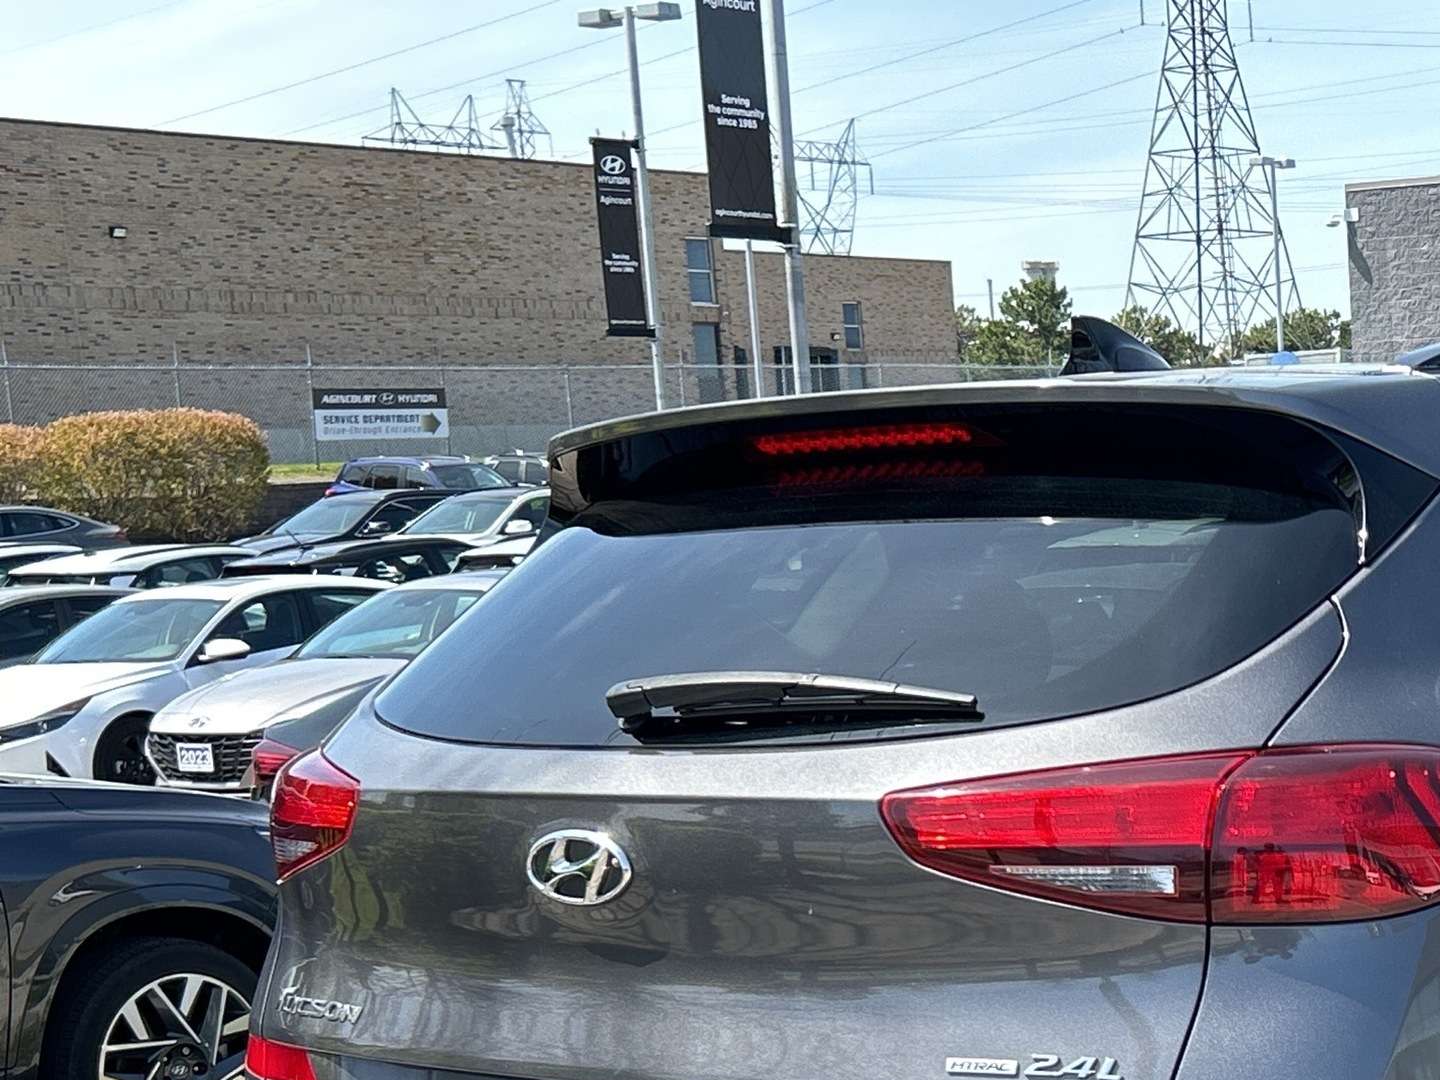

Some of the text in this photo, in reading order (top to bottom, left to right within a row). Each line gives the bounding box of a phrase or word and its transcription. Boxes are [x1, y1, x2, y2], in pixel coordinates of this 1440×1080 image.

[721, 94, 750, 108] Serving
[708, 104, 765, 120] the community
[717, 116, 737, 127] since
[598, 175, 631, 185] HYUNDAI
[600, 195, 632, 205] Agincourt
[321, 394, 438, 404] AGINCOURT HYUNDAI
[323, 414, 420, 424] SERVICE DEPARTMENT
[951, 1061, 1012, 1072] HTRAC
